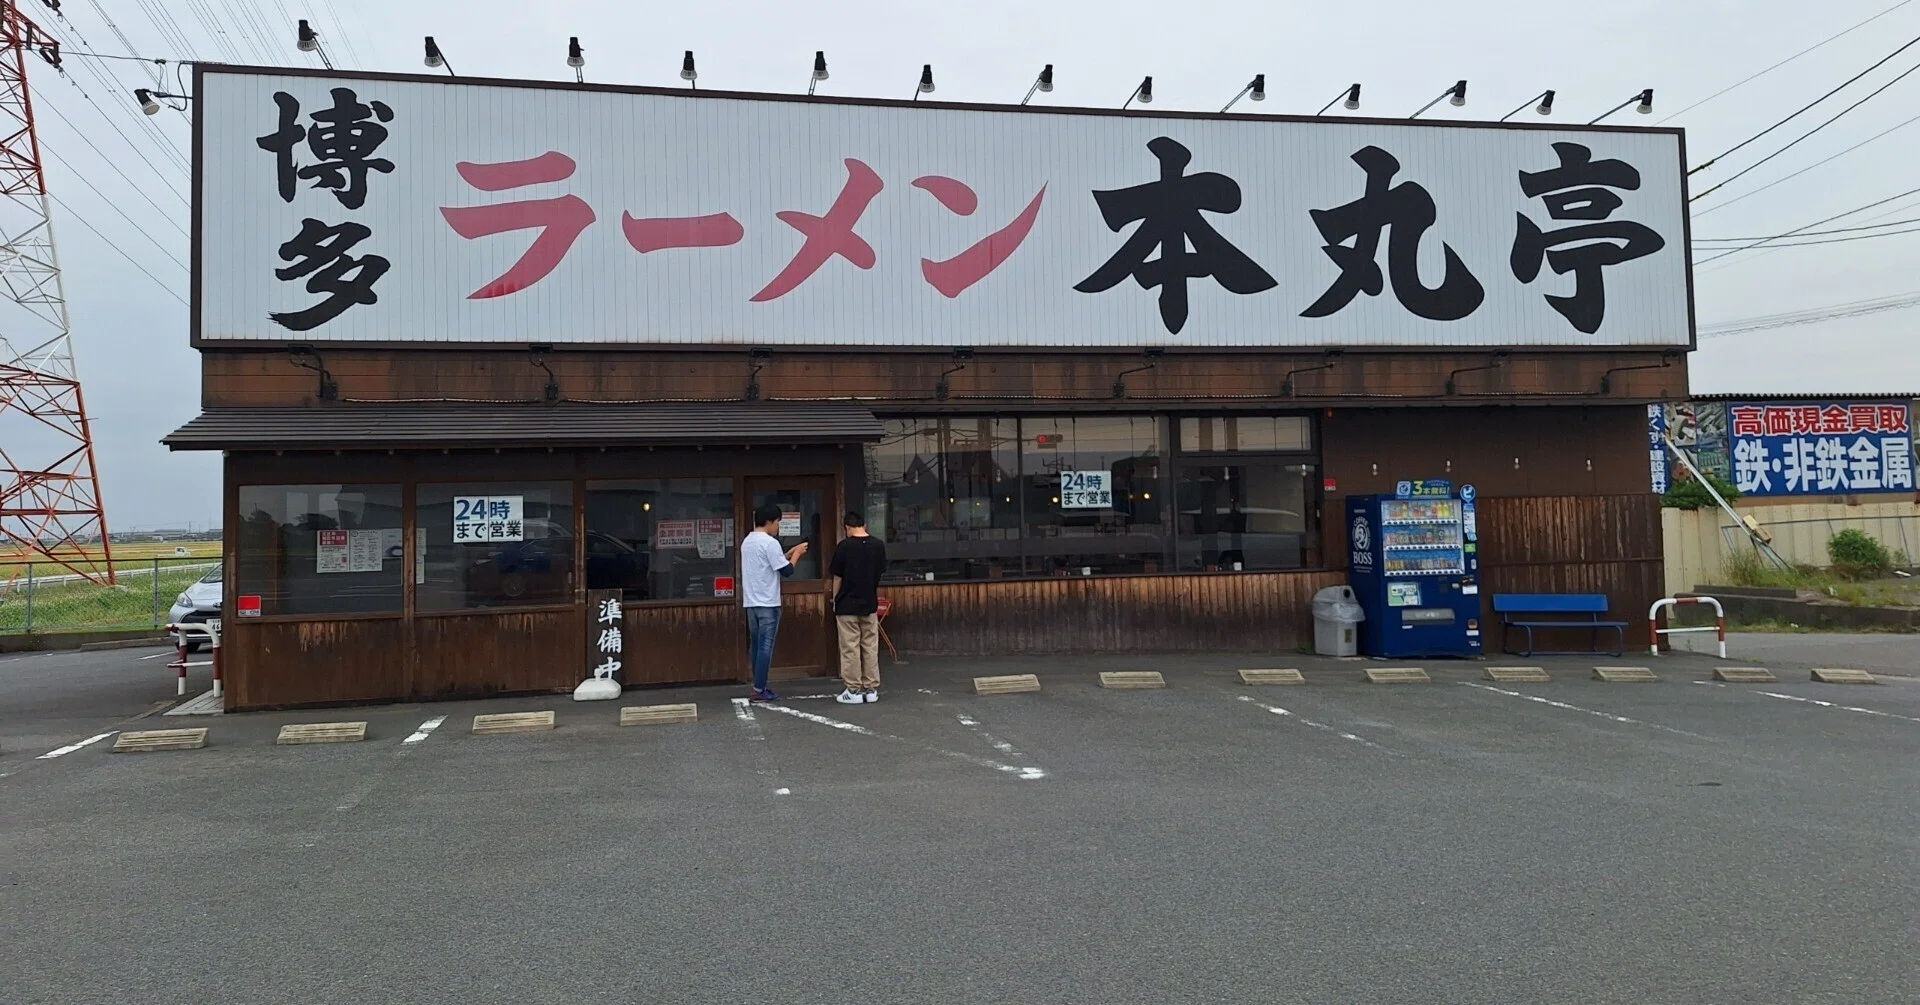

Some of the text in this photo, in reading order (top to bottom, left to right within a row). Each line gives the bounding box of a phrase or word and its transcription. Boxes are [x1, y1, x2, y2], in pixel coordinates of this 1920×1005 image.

[256, 87, 396, 331] 博多
[439, 150, 1048, 302] ラーメン
[1073, 136, 1666, 335] 本丸亭
[1731, 405, 1909, 436] 高価現金買取
[1733, 436, 1913, 493] 鉄・非鉄金属
[1063, 473, 1102, 490] 24時
[455, 499, 510, 520] 24時
[1063, 490, 1111, 505] まで営業
[456, 520, 521, 539] まで営業
[1353, 551, 1372, 565] BOSS
[597, 598, 622, 679] 準備中
